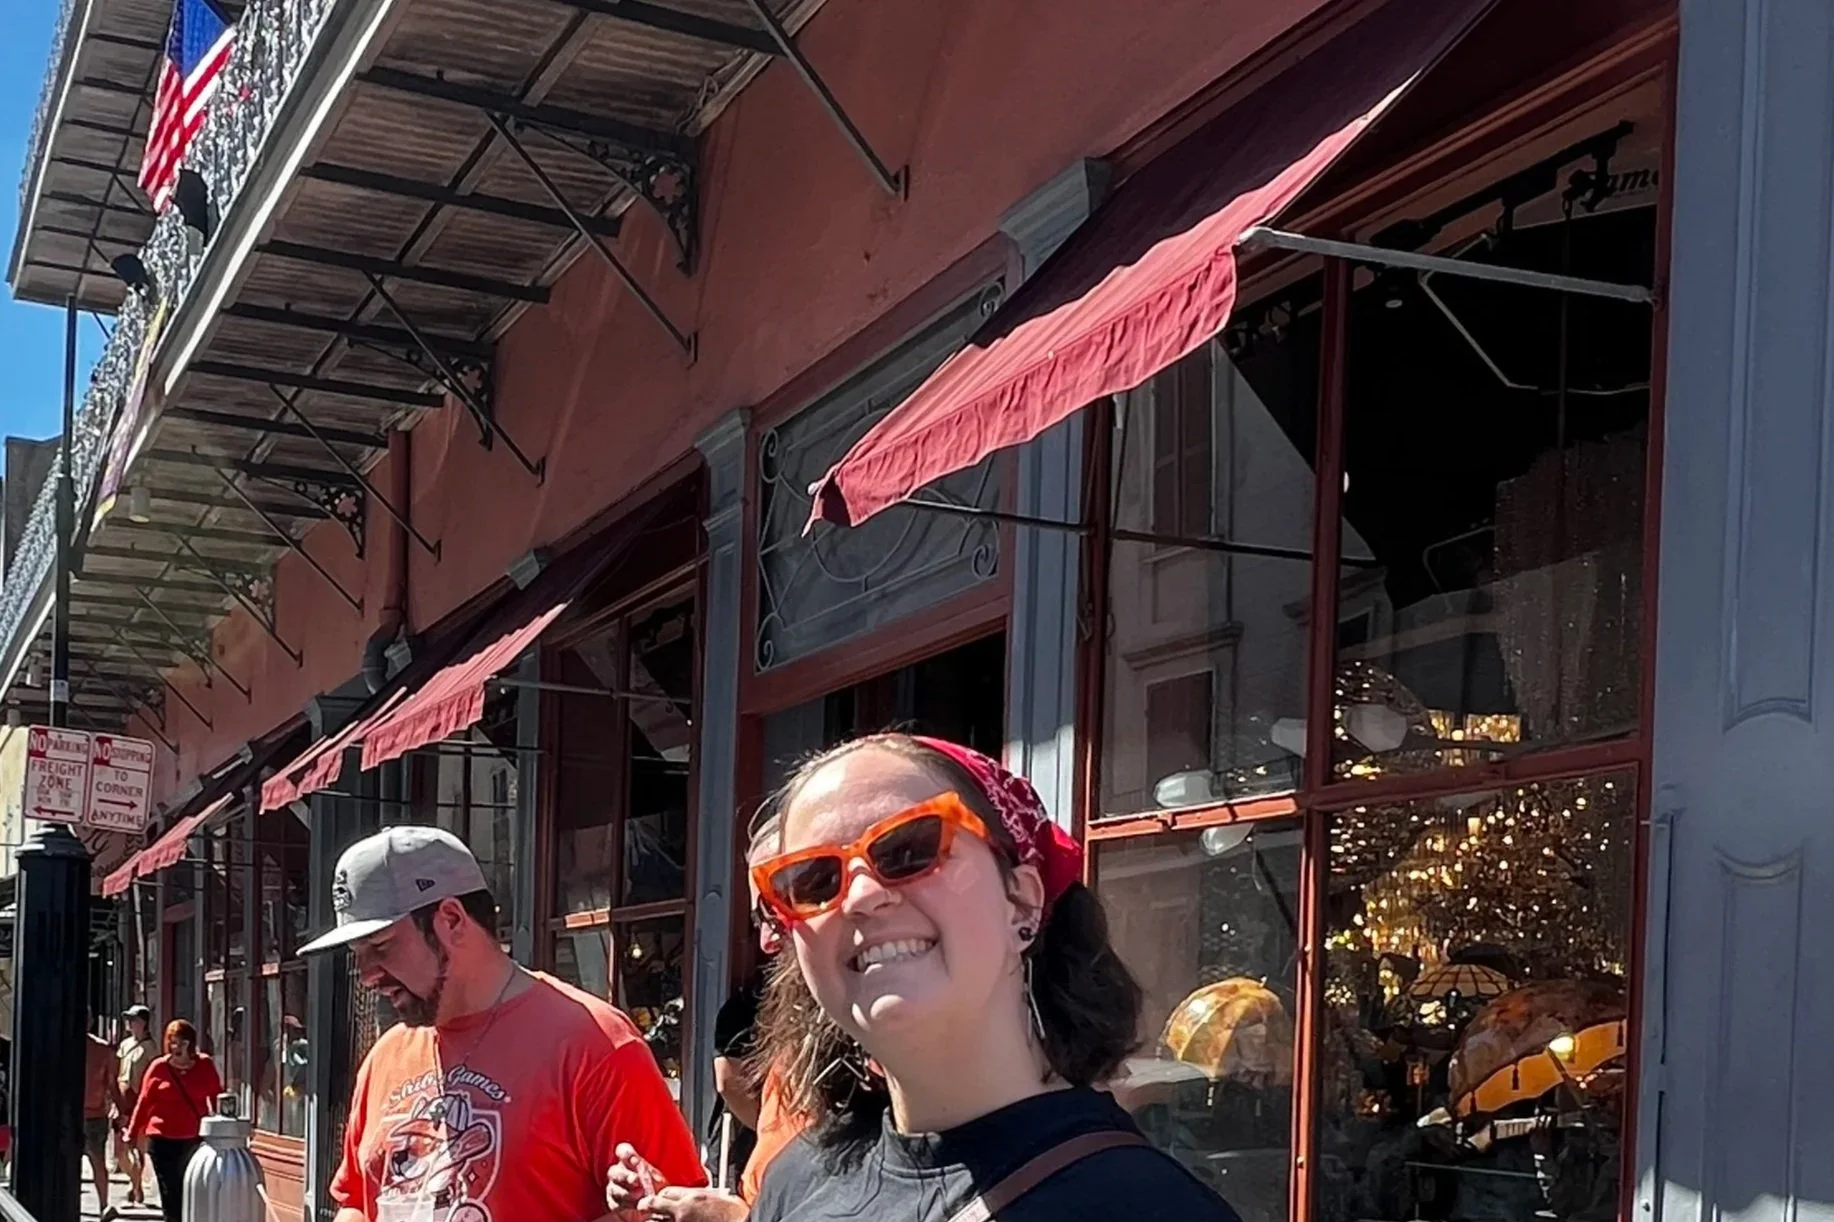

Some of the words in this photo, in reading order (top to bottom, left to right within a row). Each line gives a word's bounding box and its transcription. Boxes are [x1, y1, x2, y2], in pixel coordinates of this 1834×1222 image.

[29, 729, 47, 752] NO
[47, 738, 88, 754] PARKING
[94, 741, 111, 760] NO
[111, 747, 152, 763] STOPPING
[31, 760, 83, 776] FREIGHT
[114, 770, 128, 782] TO
[39, 773, 72, 791] ZONE
[96, 781, 144, 797] CORNER
[91, 809, 143, 827] ANYTIME
[388, 1069, 442, 1106] Shib
[447, 1064, 506, 1101] Games
